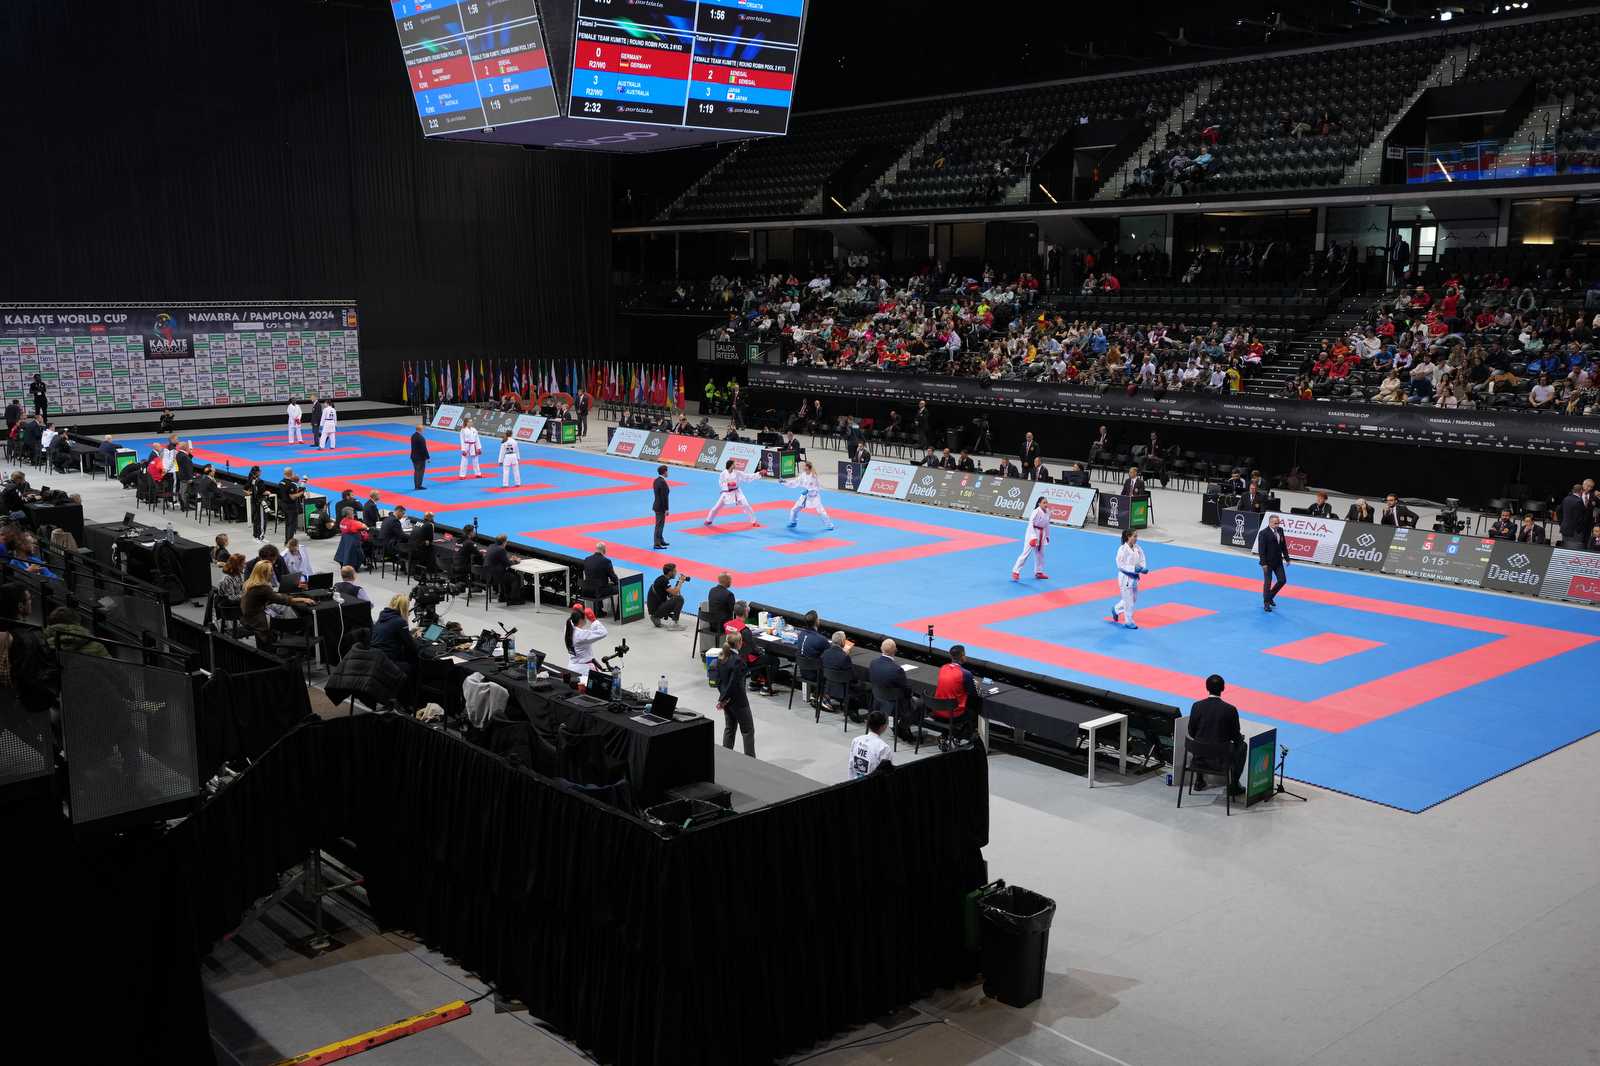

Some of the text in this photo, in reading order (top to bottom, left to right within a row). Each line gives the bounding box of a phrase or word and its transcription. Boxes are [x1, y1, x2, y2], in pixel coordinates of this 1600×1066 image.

[710, 9, 725, 20] 1:56
[579, 32, 597, 40] FEMALE
[598, 34, 609, 42] TEAM
[611, 36, 627, 44] KUMITE
[630, 39, 644, 47] ROUND
[596, 48, 601, 57] 0
[694, 56, 710, 64] FEMALE
[711, 57, 721, 65] TEAM
[739, 60, 752, 68] ROUND
[593, 75, 598, 85] 3
[708, 70, 713, 80] 2
[617, 80, 641, 88] AUSTRALIA
[738, 78, 756, 86] SENEGAL
[706, 88, 711, 96] 3
[584, 102, 601, 113] 2:32
[699, 104, 714, 114] 1:19
[4, 314, 128, 324] KARATE WORLD CUP
[188, 313, 239, 322] NAVARRA
[250, 311, 307, 321] PAMPLONA
[308, 311, 334, 320] 2024
[149, 339, 188, 348] KARATE
[909, 483, 937, 497] Daedo
[995, 496, 1025, 510] Daedo
[1279, 519, 1329, 534] ARENA
[1423, 542, 1431, 550] 5
[1448, 545, 1456, 553] 0
[1338, 544, 1383, 562] Daedo
[1395, 568, 1418, 576] FEMALE
[1436, 574, 1460, 582] KUMITE
[1463, 578, 1480, 586] POOL
[1487, 564, 1540, 585] Daedo
[857, 747, 868, 757] VIE
